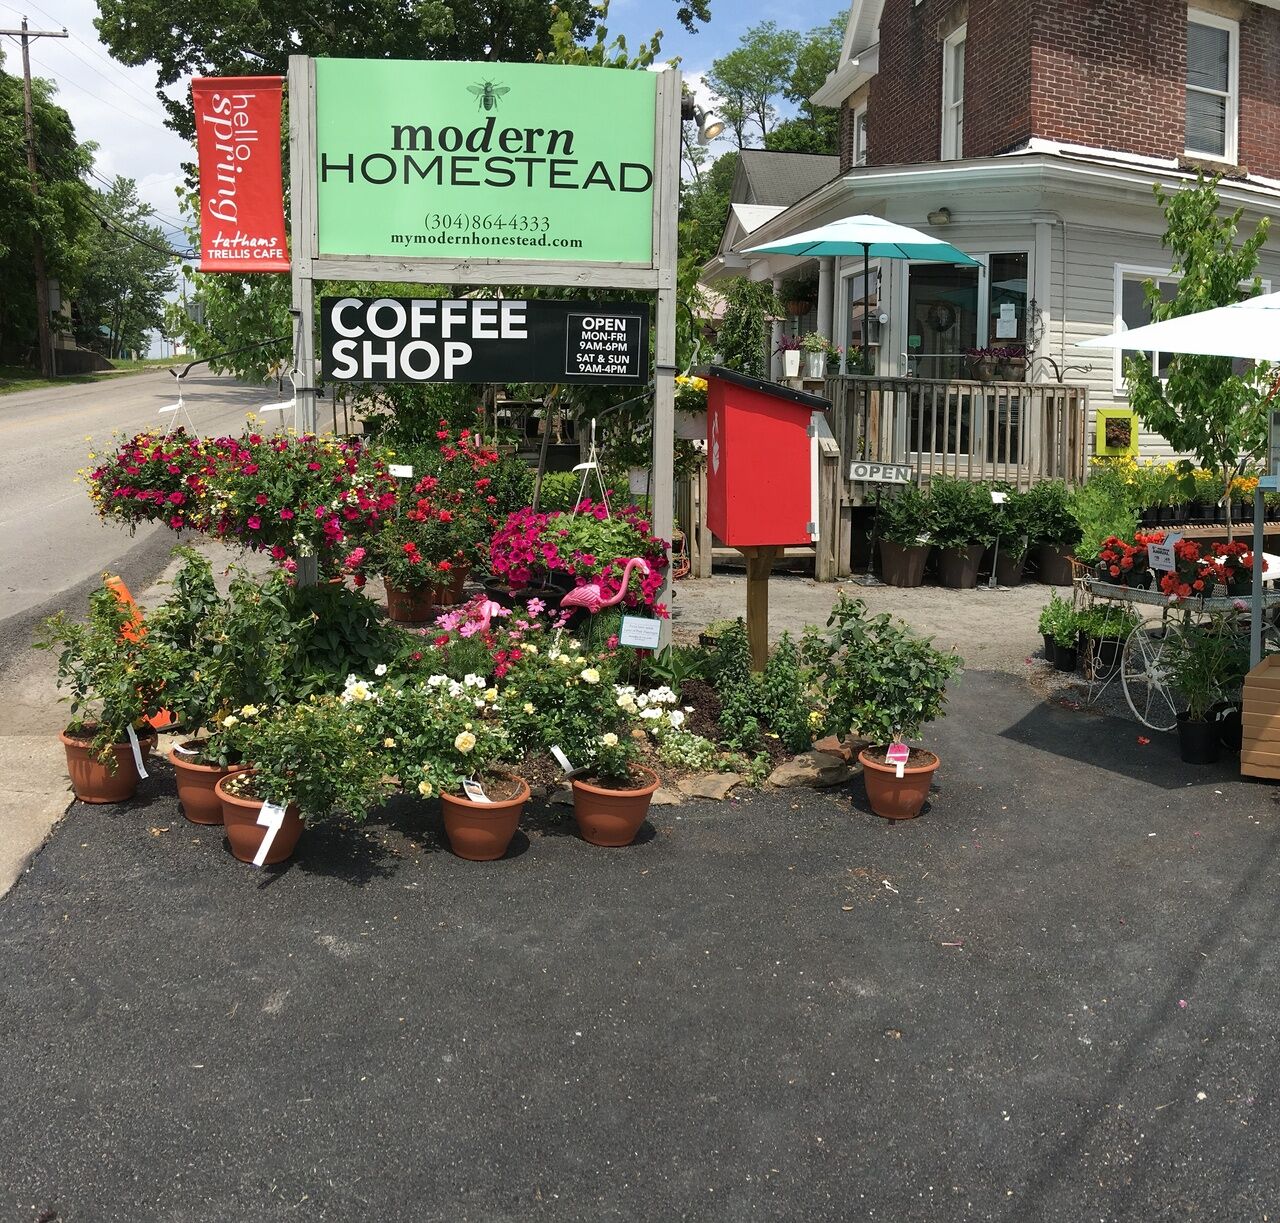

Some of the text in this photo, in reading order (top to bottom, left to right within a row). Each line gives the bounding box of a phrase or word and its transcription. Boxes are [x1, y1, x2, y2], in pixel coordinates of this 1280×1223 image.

[232, 94, 259, 161] hello
[390, 116, 575, 156] modern
[203, 93, 243, 225] spring
[321, 152, 654, 193] HOMESTEAD
[424, 212, 550, 232] (304)864-4333
[211, 230, 278, 248] tathams
[207, 249, 283, 259] TRELLIS CAFE
[330, 298, 528, 339] COFFEE
[582, 316, 626, 331] OPEN
[581, 331, 627, 341] MON-FRI
[579, 341, 628, 351] 9AM-6PM
[331, 340, 473, 380] SHOP
[576, 353, 630, 364] SAT & SUN
[578, 363, 627, 374] 9AM-4PM
[854, 465, 909, 480] OPEN
